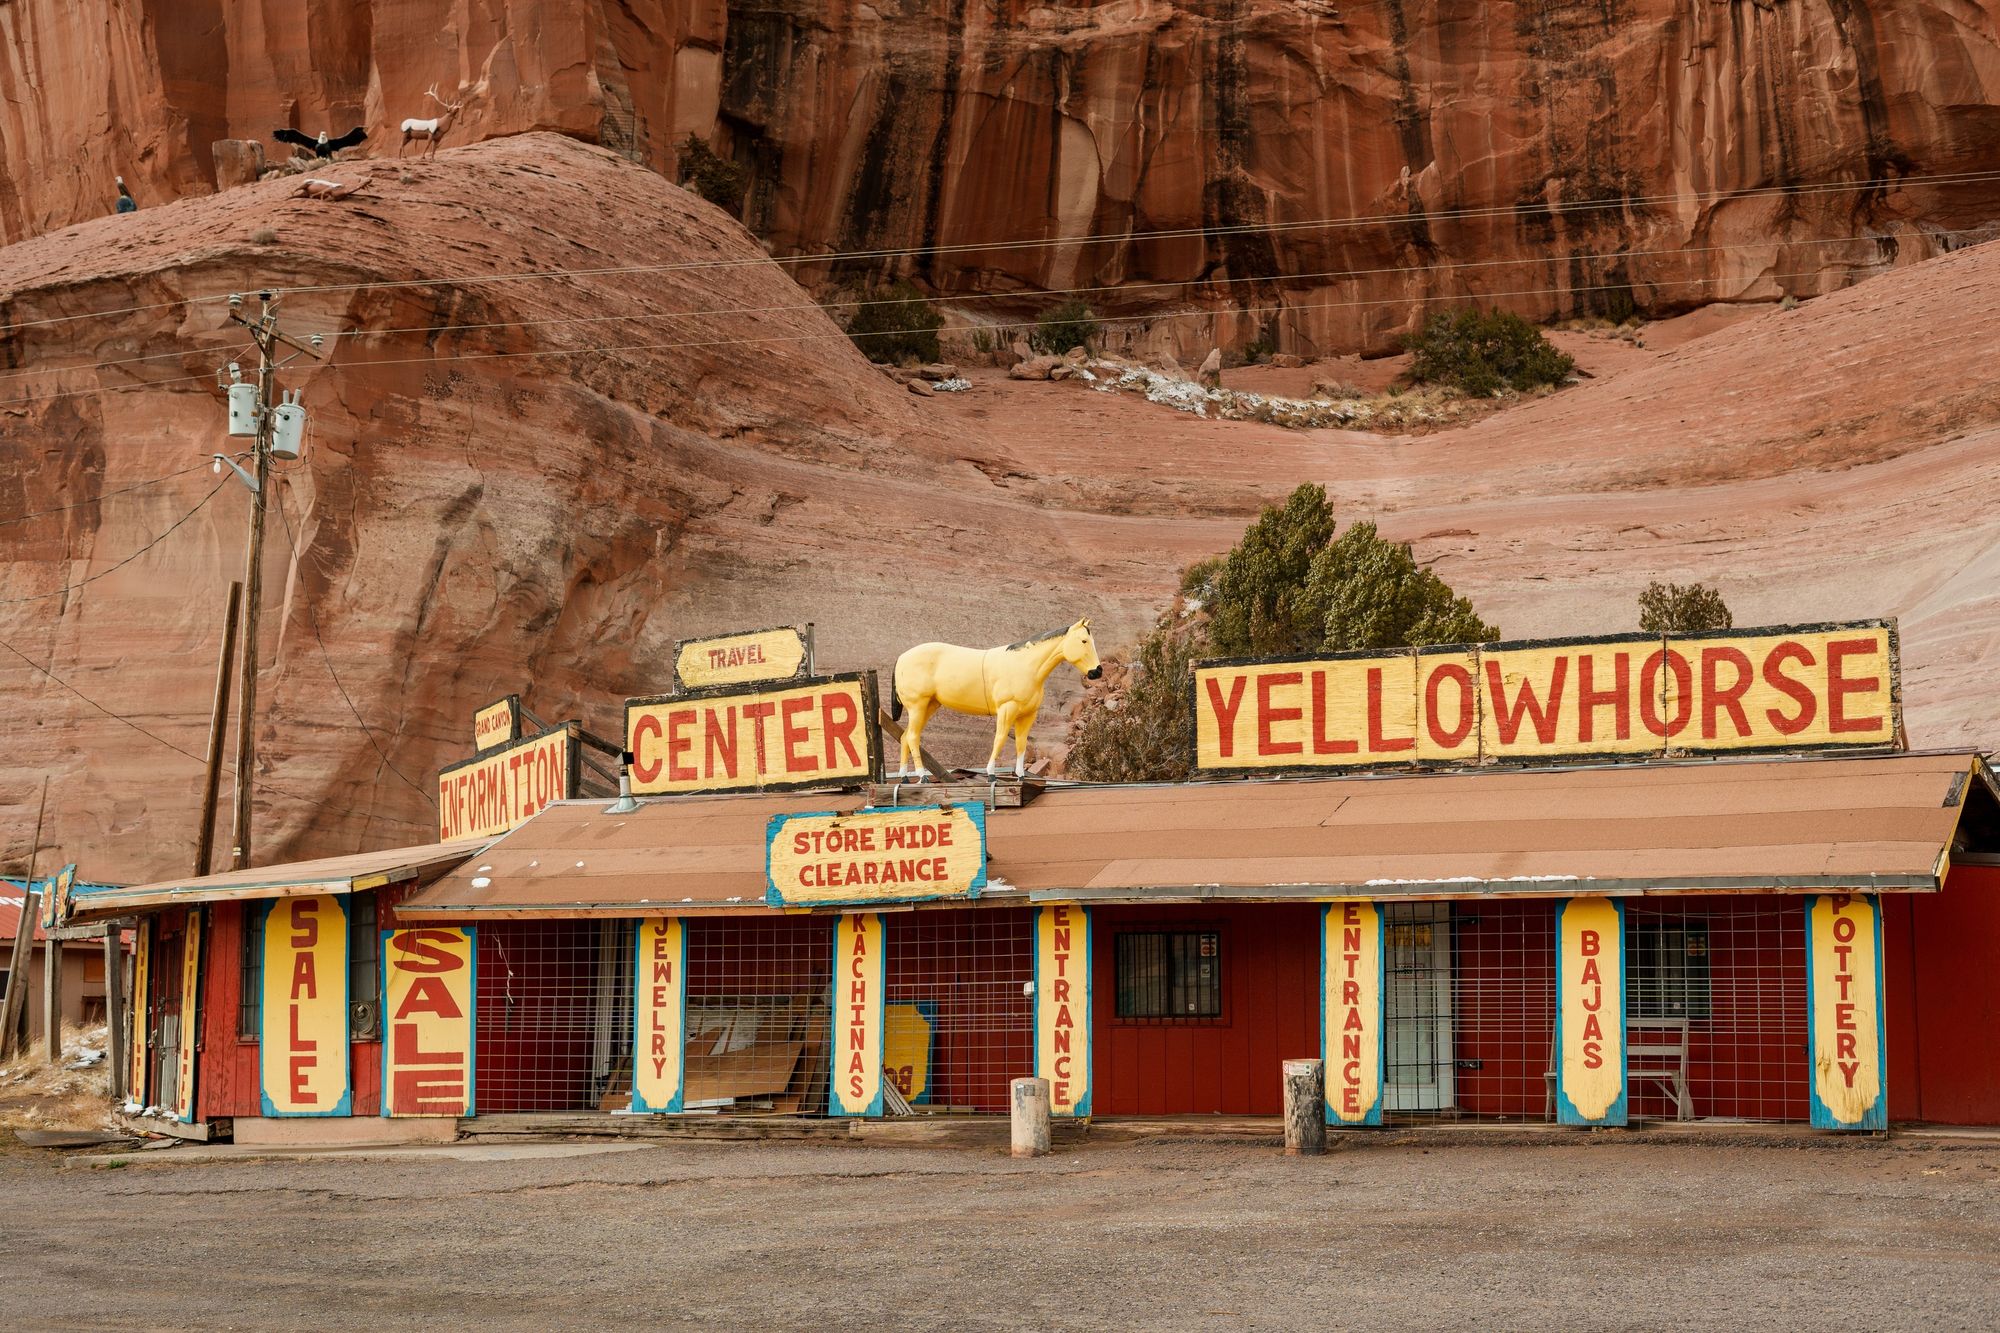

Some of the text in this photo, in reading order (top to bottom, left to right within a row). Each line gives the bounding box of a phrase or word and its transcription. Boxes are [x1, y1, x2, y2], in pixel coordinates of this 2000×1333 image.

[476, 709, 510, 738] GRAND CANYON
[708, 644, 766, 669] TRAVEL
[1205, 638, 1883, 758] YELLOWHORSE
[441, 739, 565, 840] INFORMATION
[632, 691, 862, 784] CENTER
[794, 823, 953, 854] STORE WIDE
[799, 857, 949, 887] CLEARANCE
[290, 900, 318, 1104] SALE
[393, 930, 463, 1114] SALE
[653, 917, 672, 1080] JEWELRY
[849, 912, 868, 1098] KACHINAS
[1053, 906, 1072, 1106] ENTRANCE
[1342, 904, 1365, 1114] ENTRANCE
[1580, 930, 1603, 1069] BAJAS
[1830, 893, 1860, 1089] POTTERY
